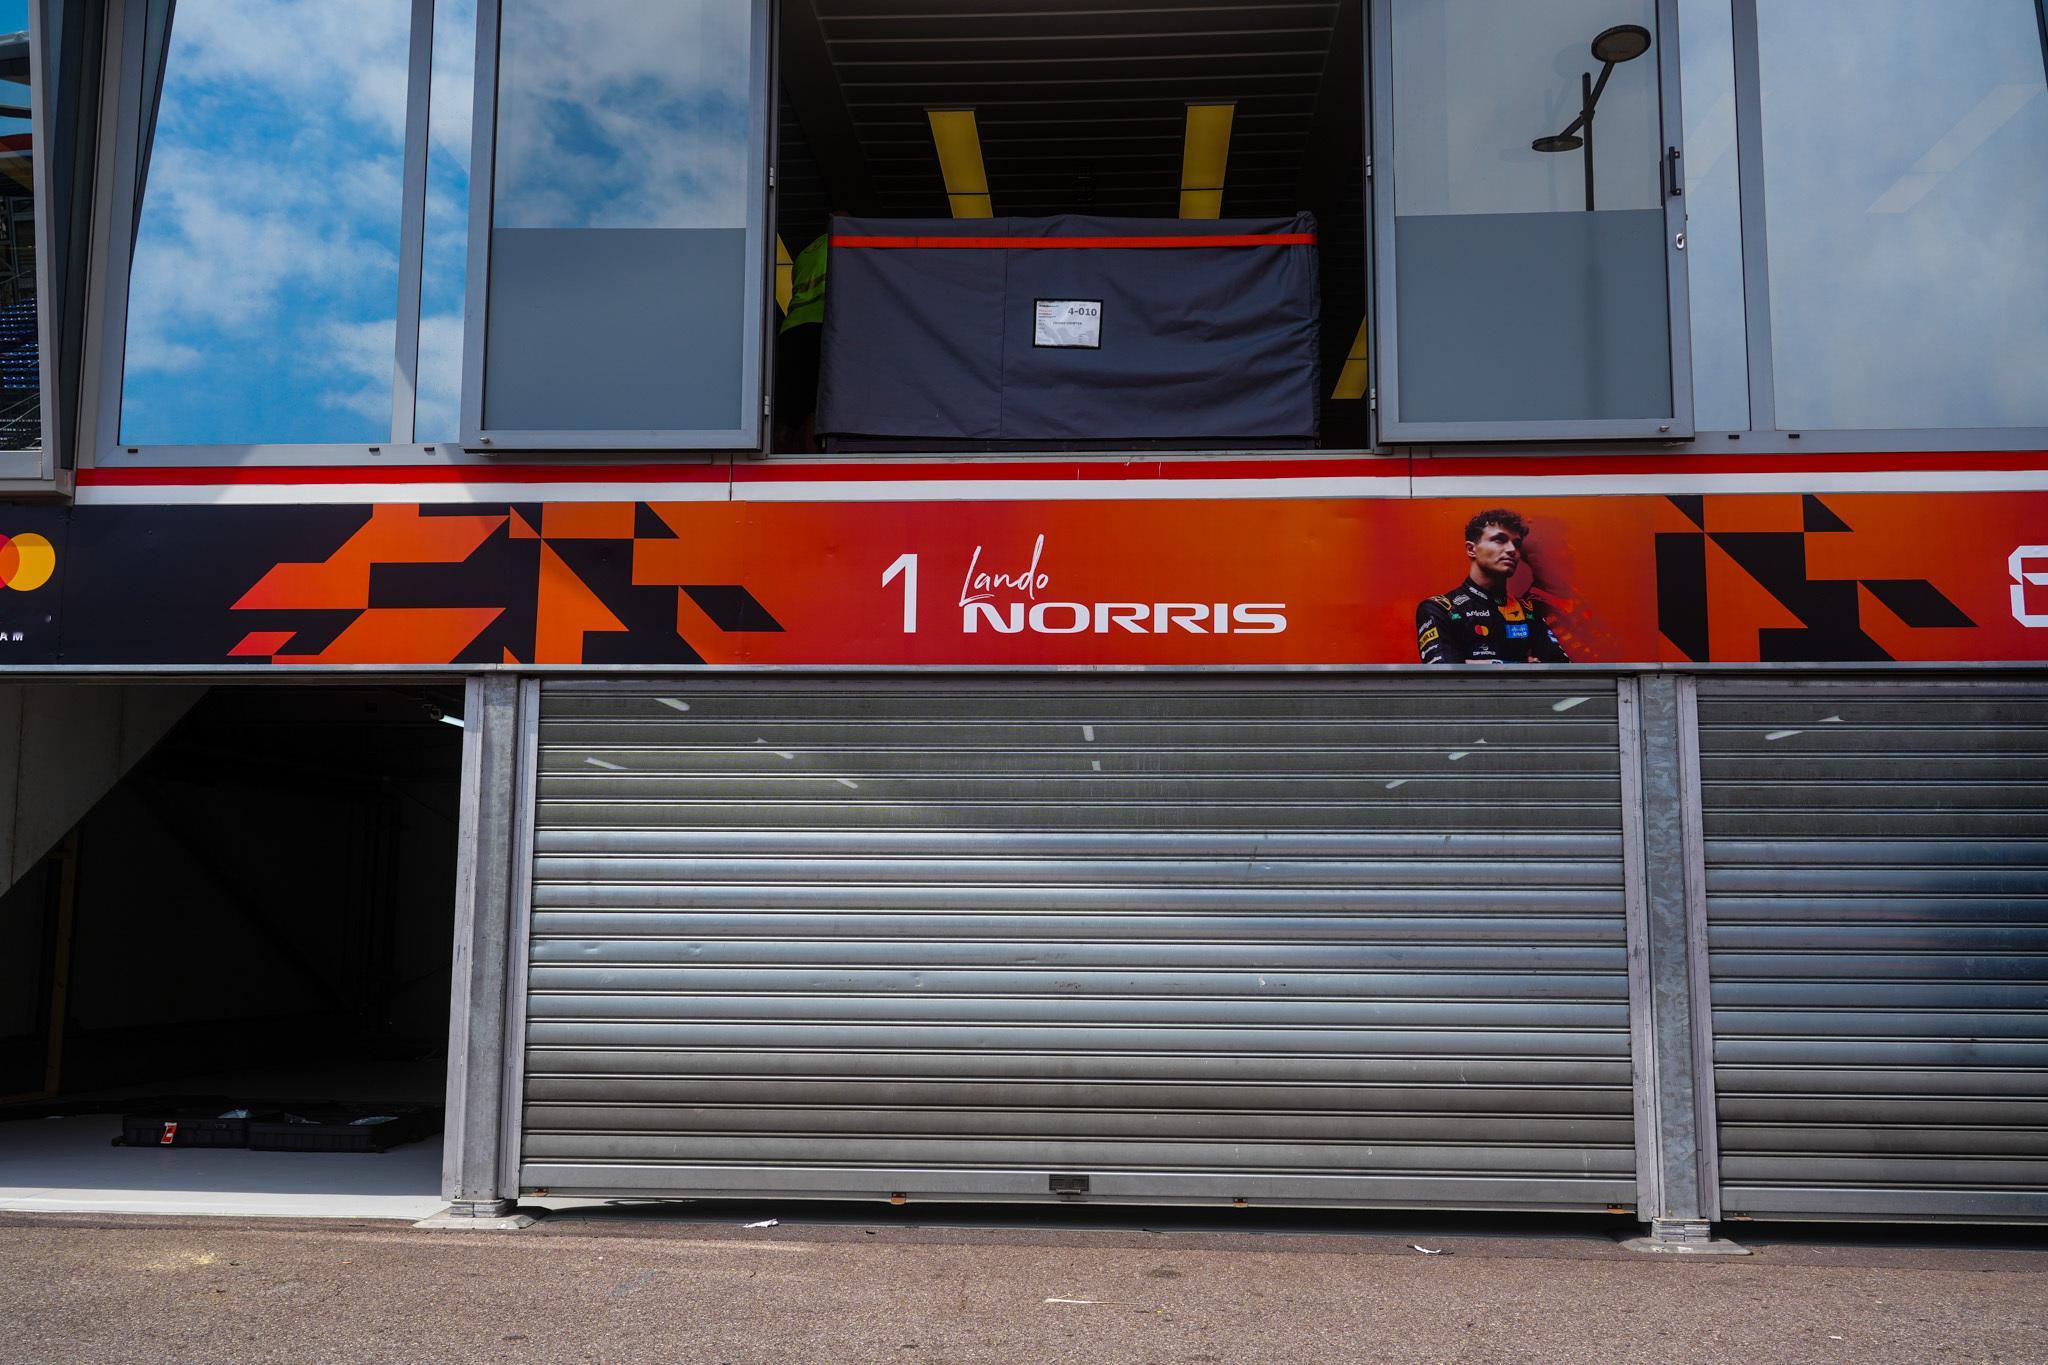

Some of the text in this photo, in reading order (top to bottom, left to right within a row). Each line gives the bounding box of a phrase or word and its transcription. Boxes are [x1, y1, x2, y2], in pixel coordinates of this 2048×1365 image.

[1068, 307, 1097, 317] 4-010
[882, 554, 918, 633] 1
[959, 533, 1049, 608] Lando
[963, 602, 1287, 634] NORRIS
